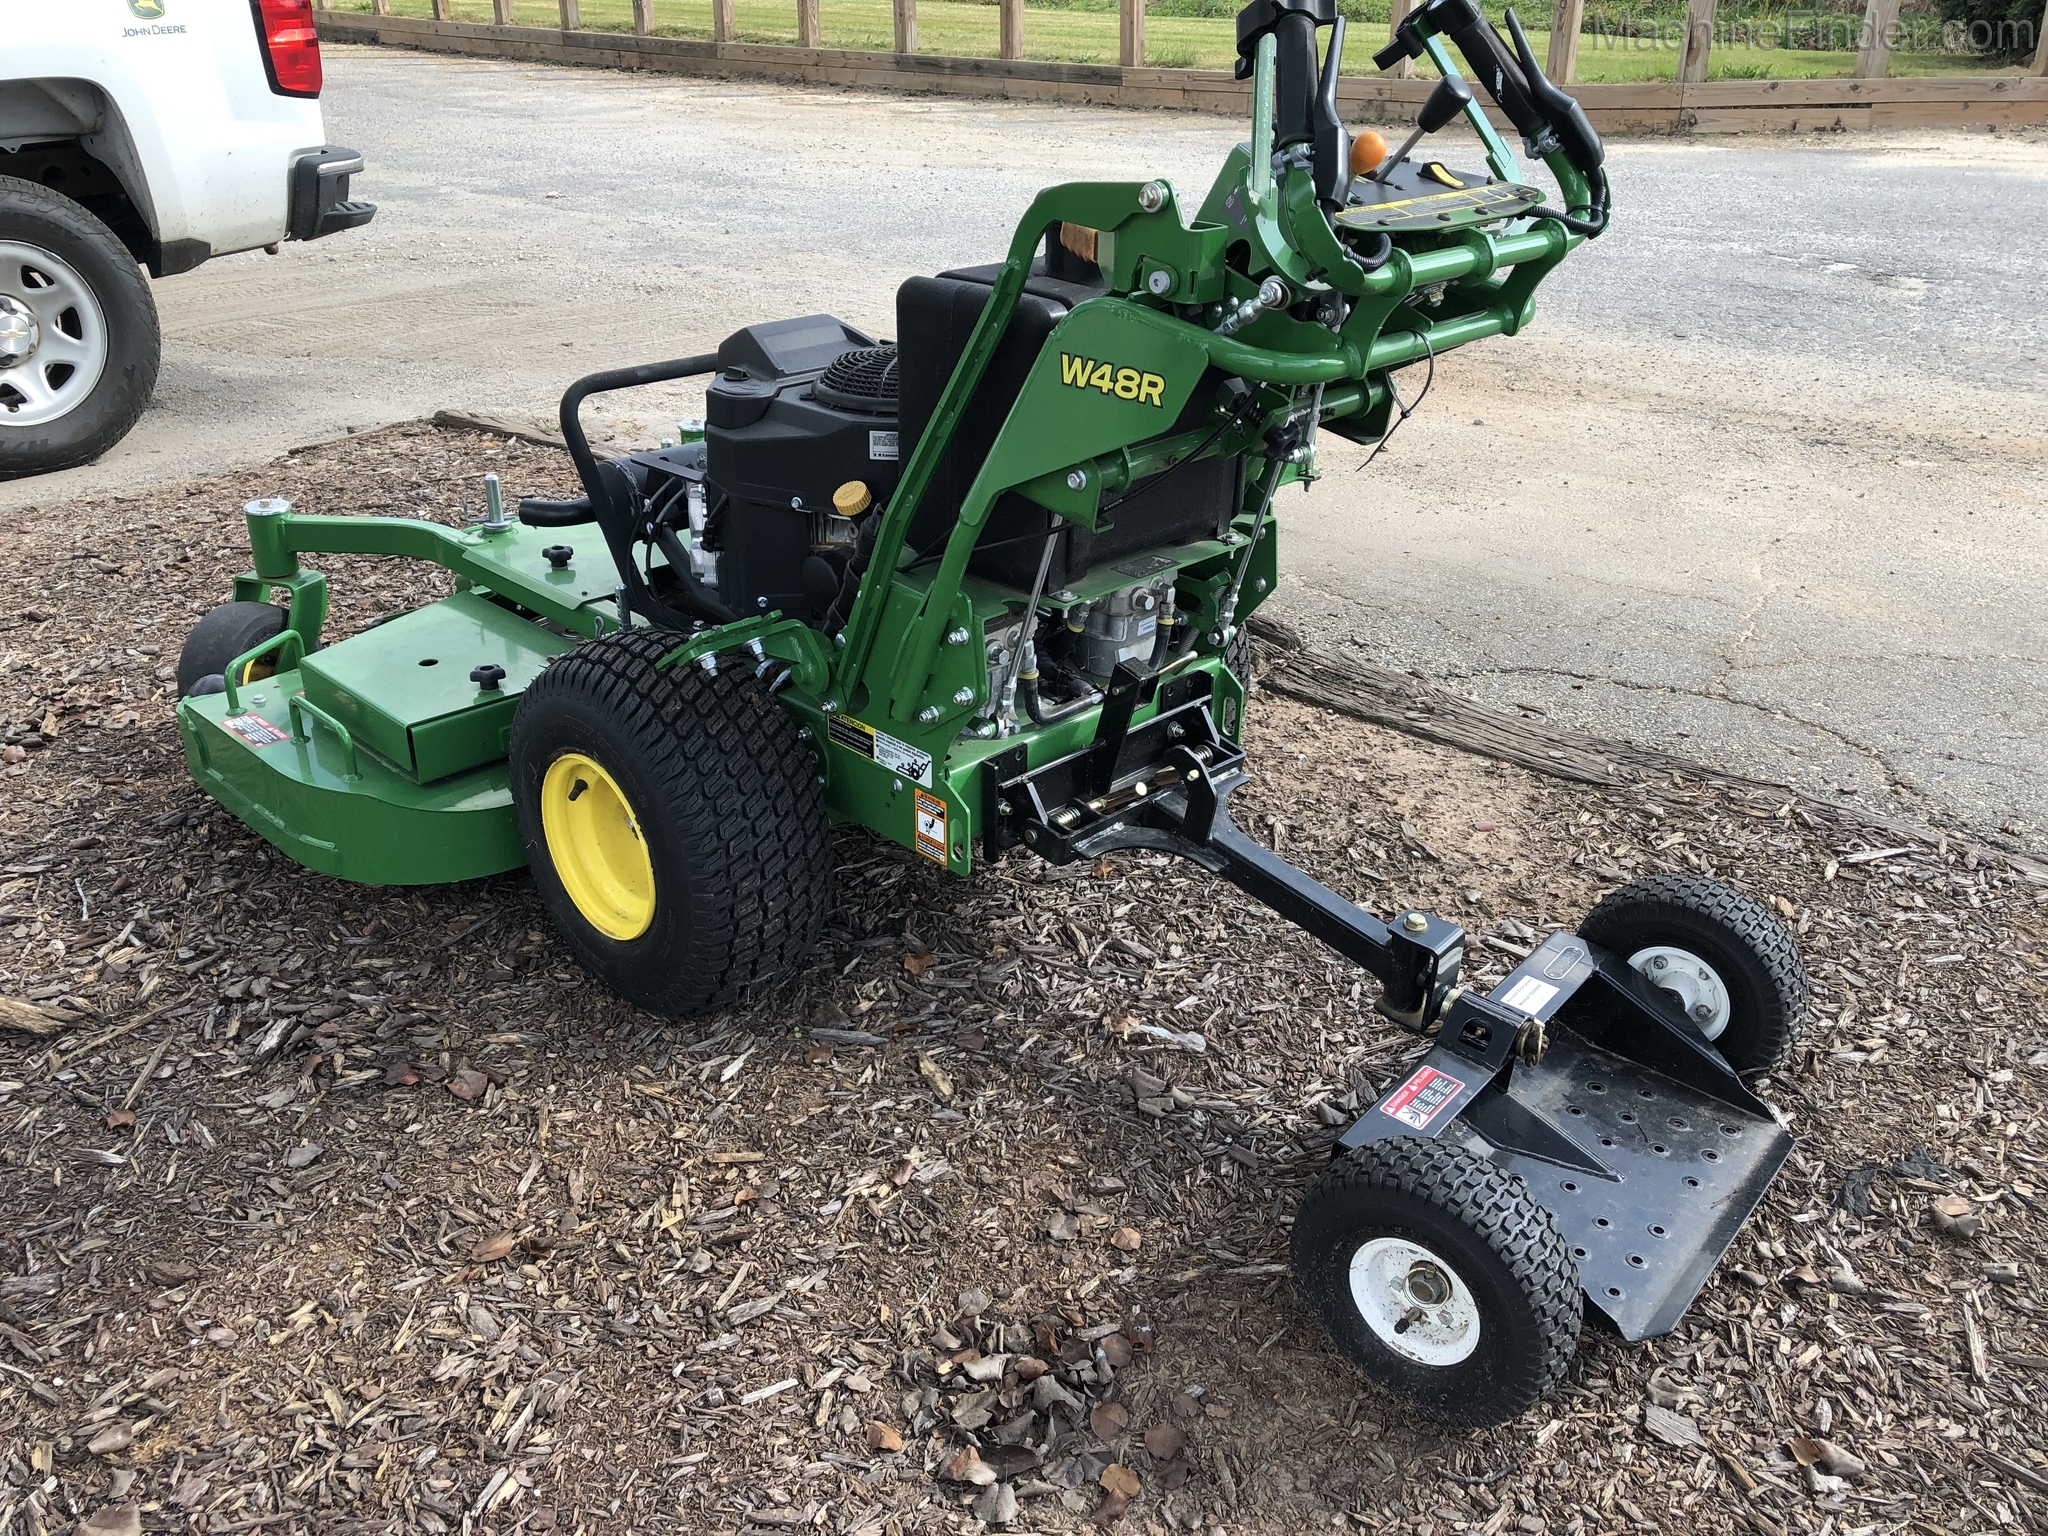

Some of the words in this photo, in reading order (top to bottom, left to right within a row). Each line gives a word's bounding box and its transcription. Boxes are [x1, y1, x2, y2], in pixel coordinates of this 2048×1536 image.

[122, 27, 151, 38] JOHN
[151, 25, 187, 35] DEERE
[1060, 351, 1166, 409] W48R
[1412, 1068, 1433, 1086] PELIGRO
[1390, 1090, 1410, 1108] DANGER
